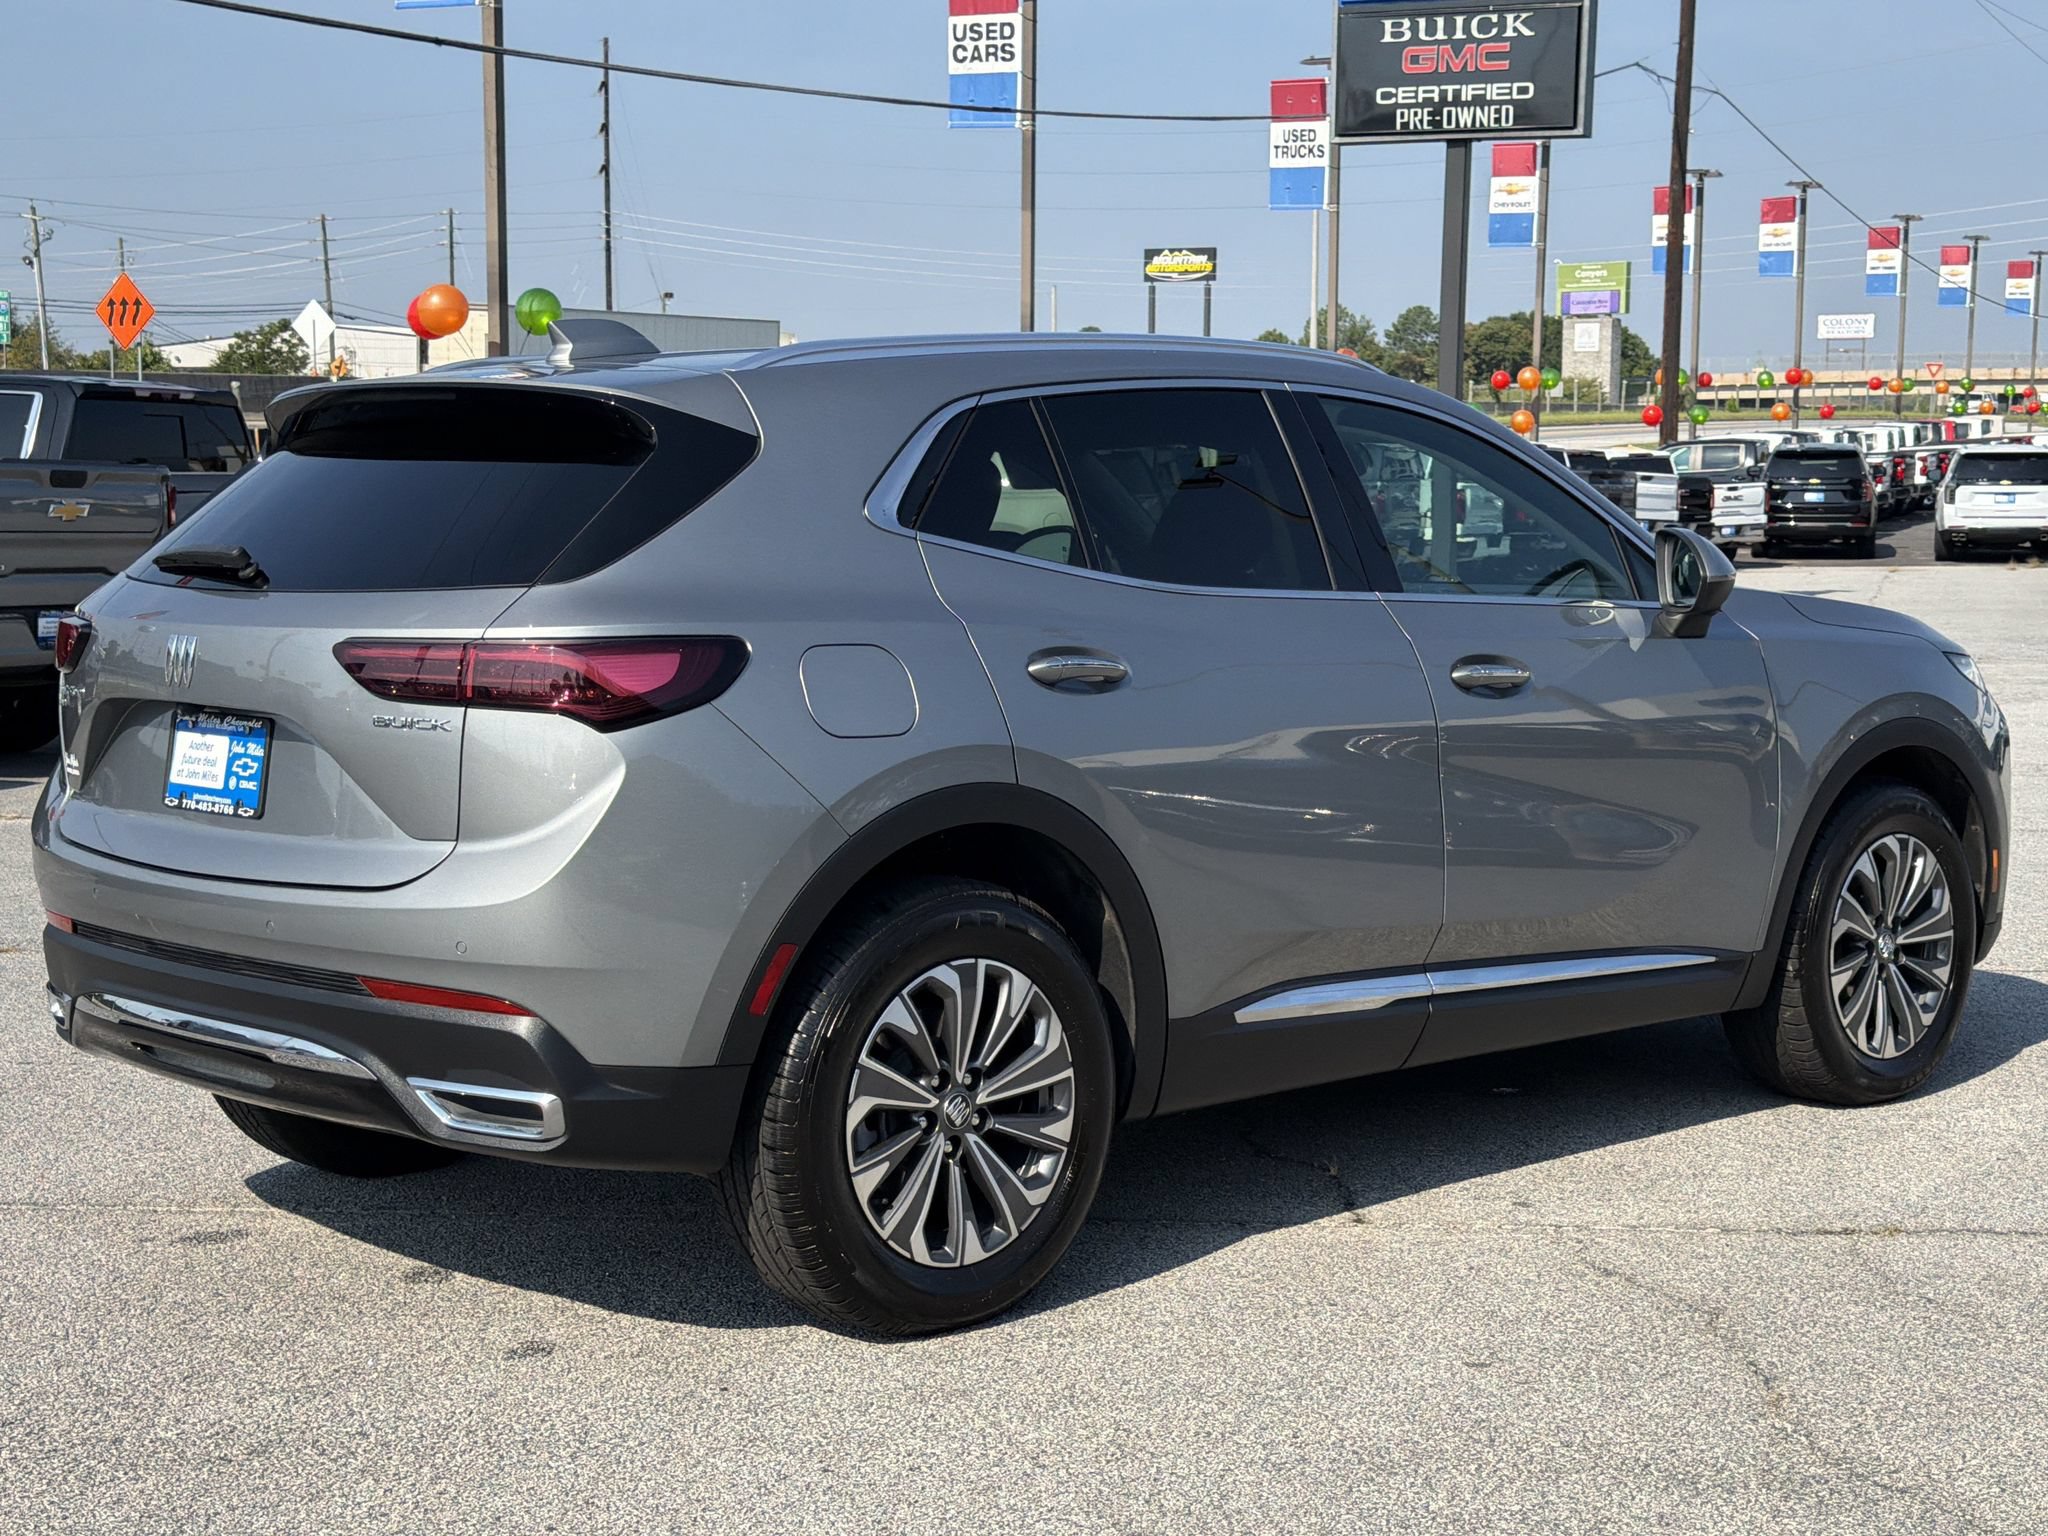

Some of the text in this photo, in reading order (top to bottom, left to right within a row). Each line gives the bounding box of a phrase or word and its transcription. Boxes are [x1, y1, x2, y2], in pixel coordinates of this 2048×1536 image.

[952, 22, 1015, 42] USED
[1380, 12, 1536, 43] BUICK
[952, 43, 1016, 63] CARS
[1402, 42, 1511, 74] GMC
[1376, 82, 1535, 104] CERTIFIED
[1395, 105, 1514, 130] PRE-OWNED
[1283, 128, 1317, 143] USED
[1273, 144, 1325, 159] TRUCKS
[1823, 318, 1869, 327] COLONY
[223, 715, 264, 729] Chevrolet
[373, 715, 452, 733] BUICK
[189, 740, 214, 752] Another
[229, 740, 265, 758] John Miles
[181, 753, 218, 768] future deal
[176, 769, 220, 782] at John Miles
[238, 780, 258, 791] GMC
[182, 799, 235, 815] 770-483-8766
